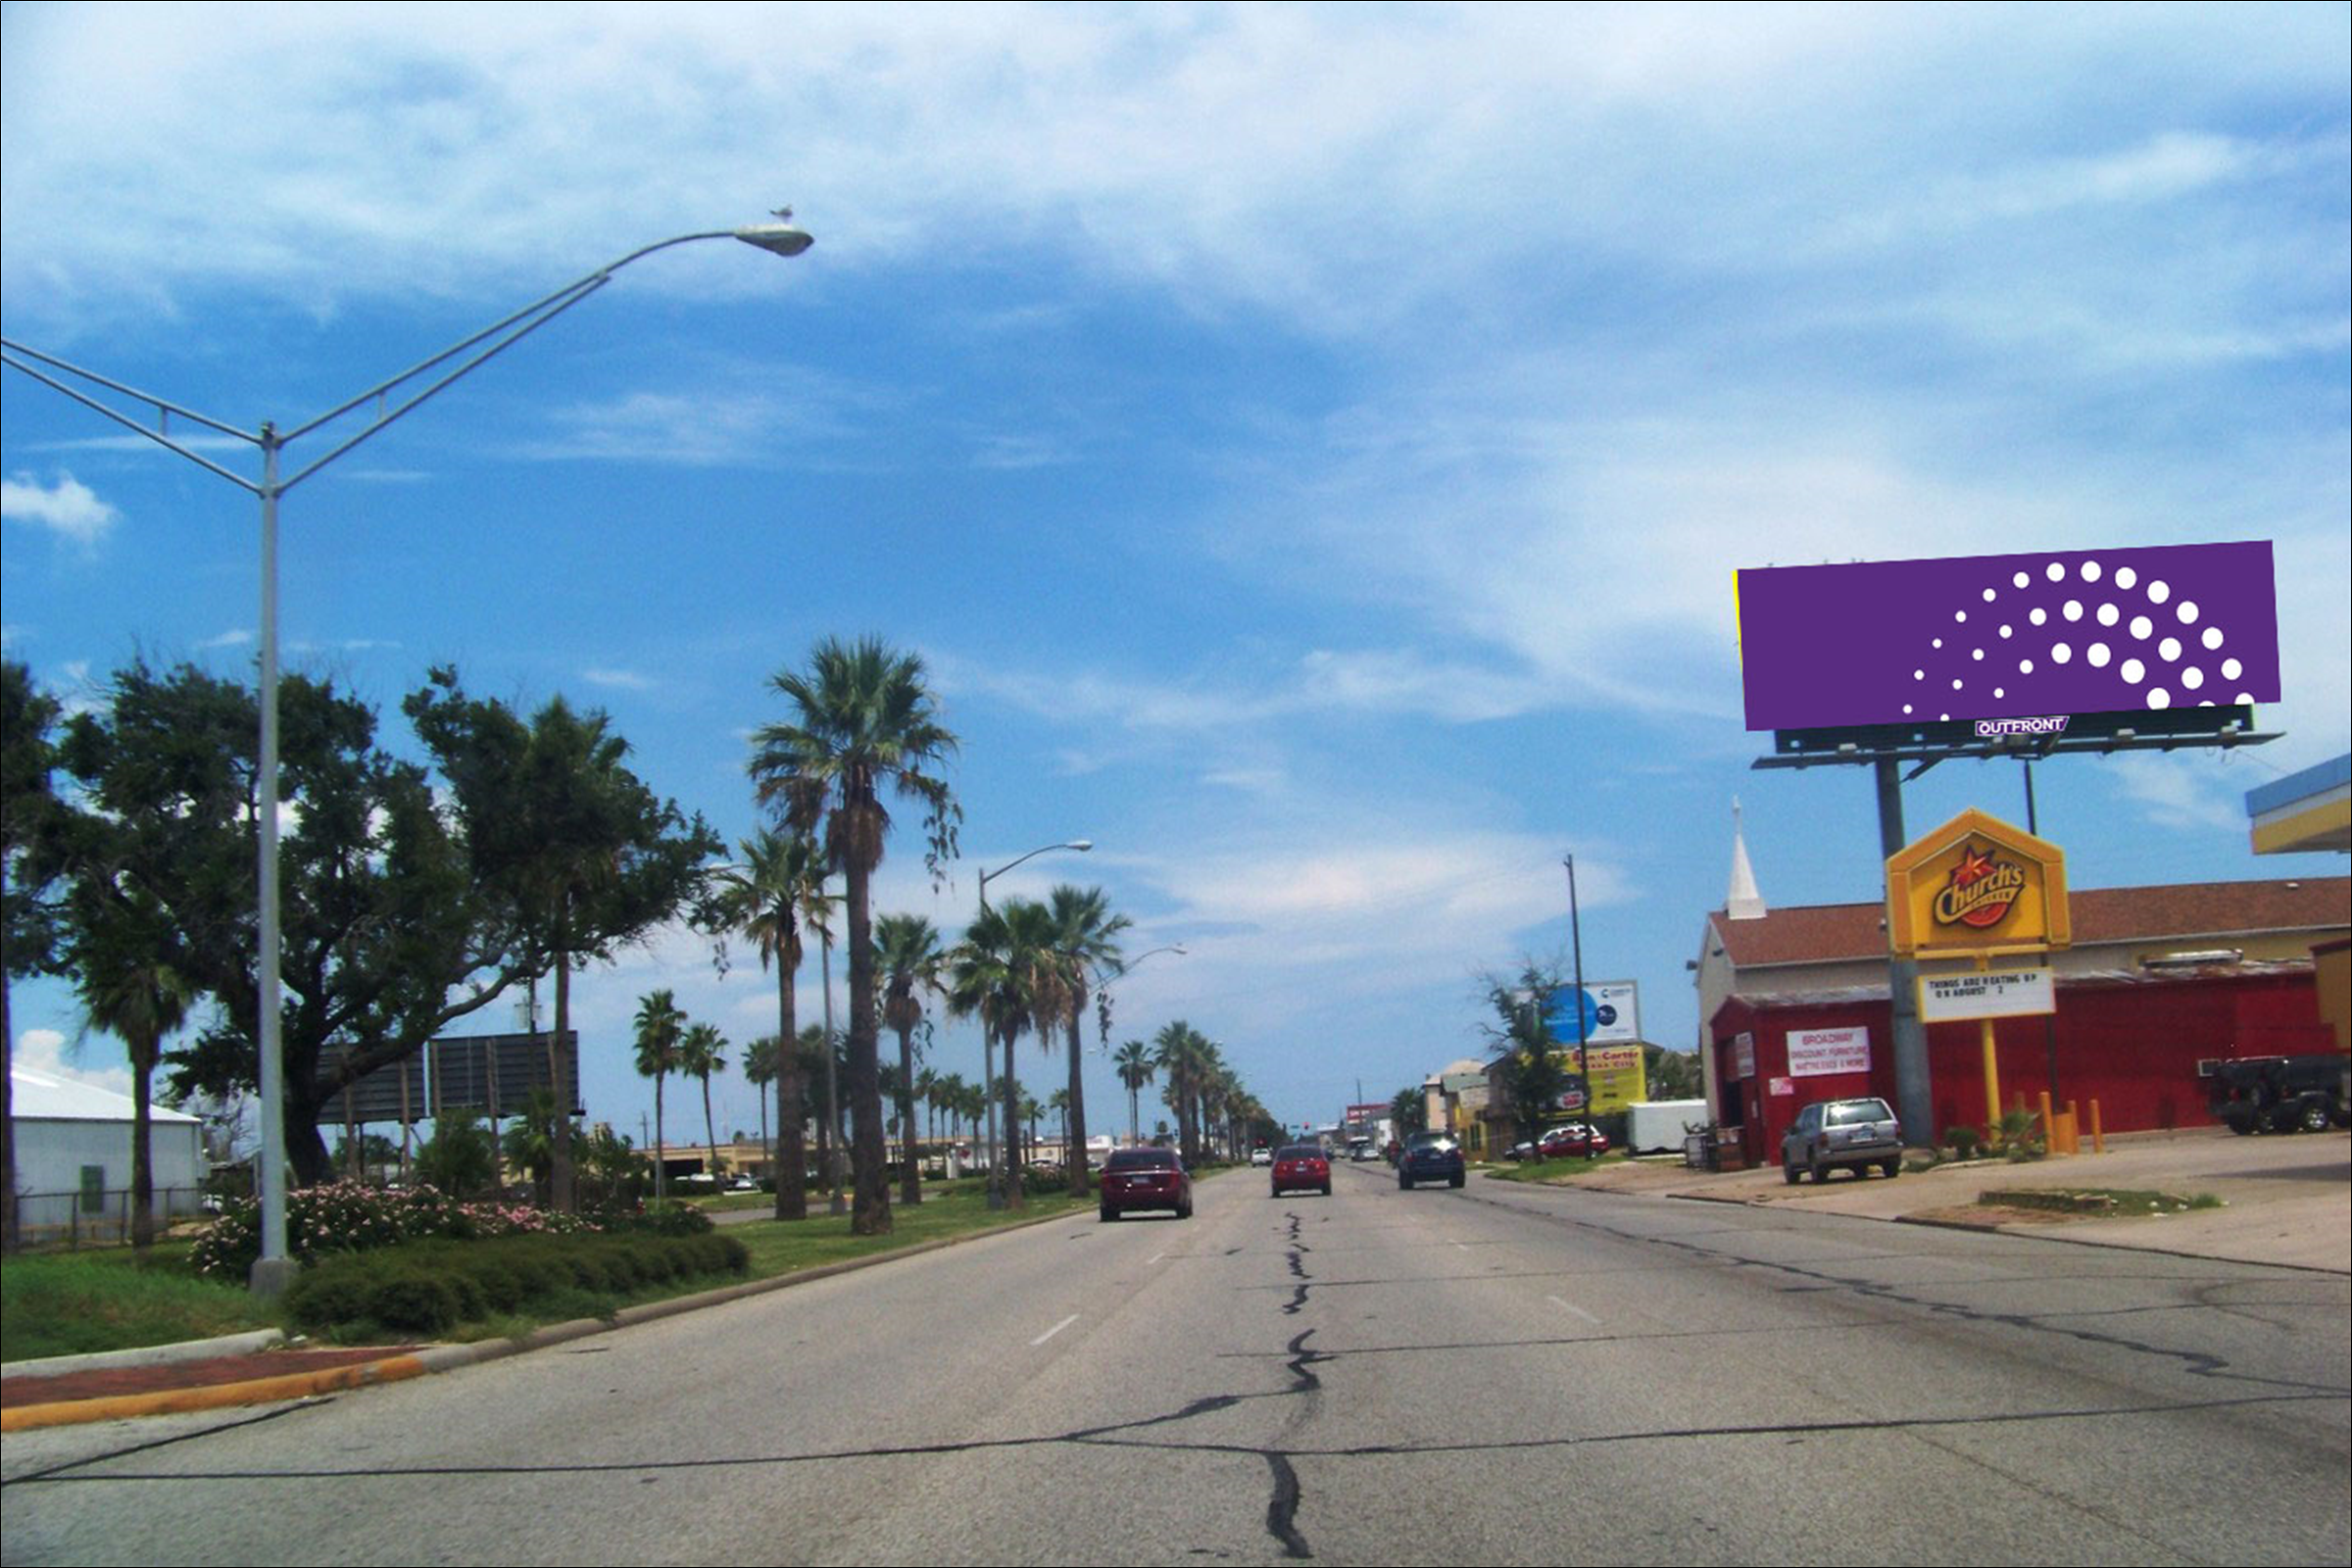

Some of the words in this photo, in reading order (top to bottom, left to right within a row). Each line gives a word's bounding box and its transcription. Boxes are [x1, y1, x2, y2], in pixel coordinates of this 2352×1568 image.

[1980, 718, 2064, 734] OUTFRONT
[1935, 862, 2024, 923] Church's
[1930, 980, 1960, 989] THINGS
[1953, 986, 1986, 997] AUGUST
[1802, 1033, 1853, 1045] BROADWAY
